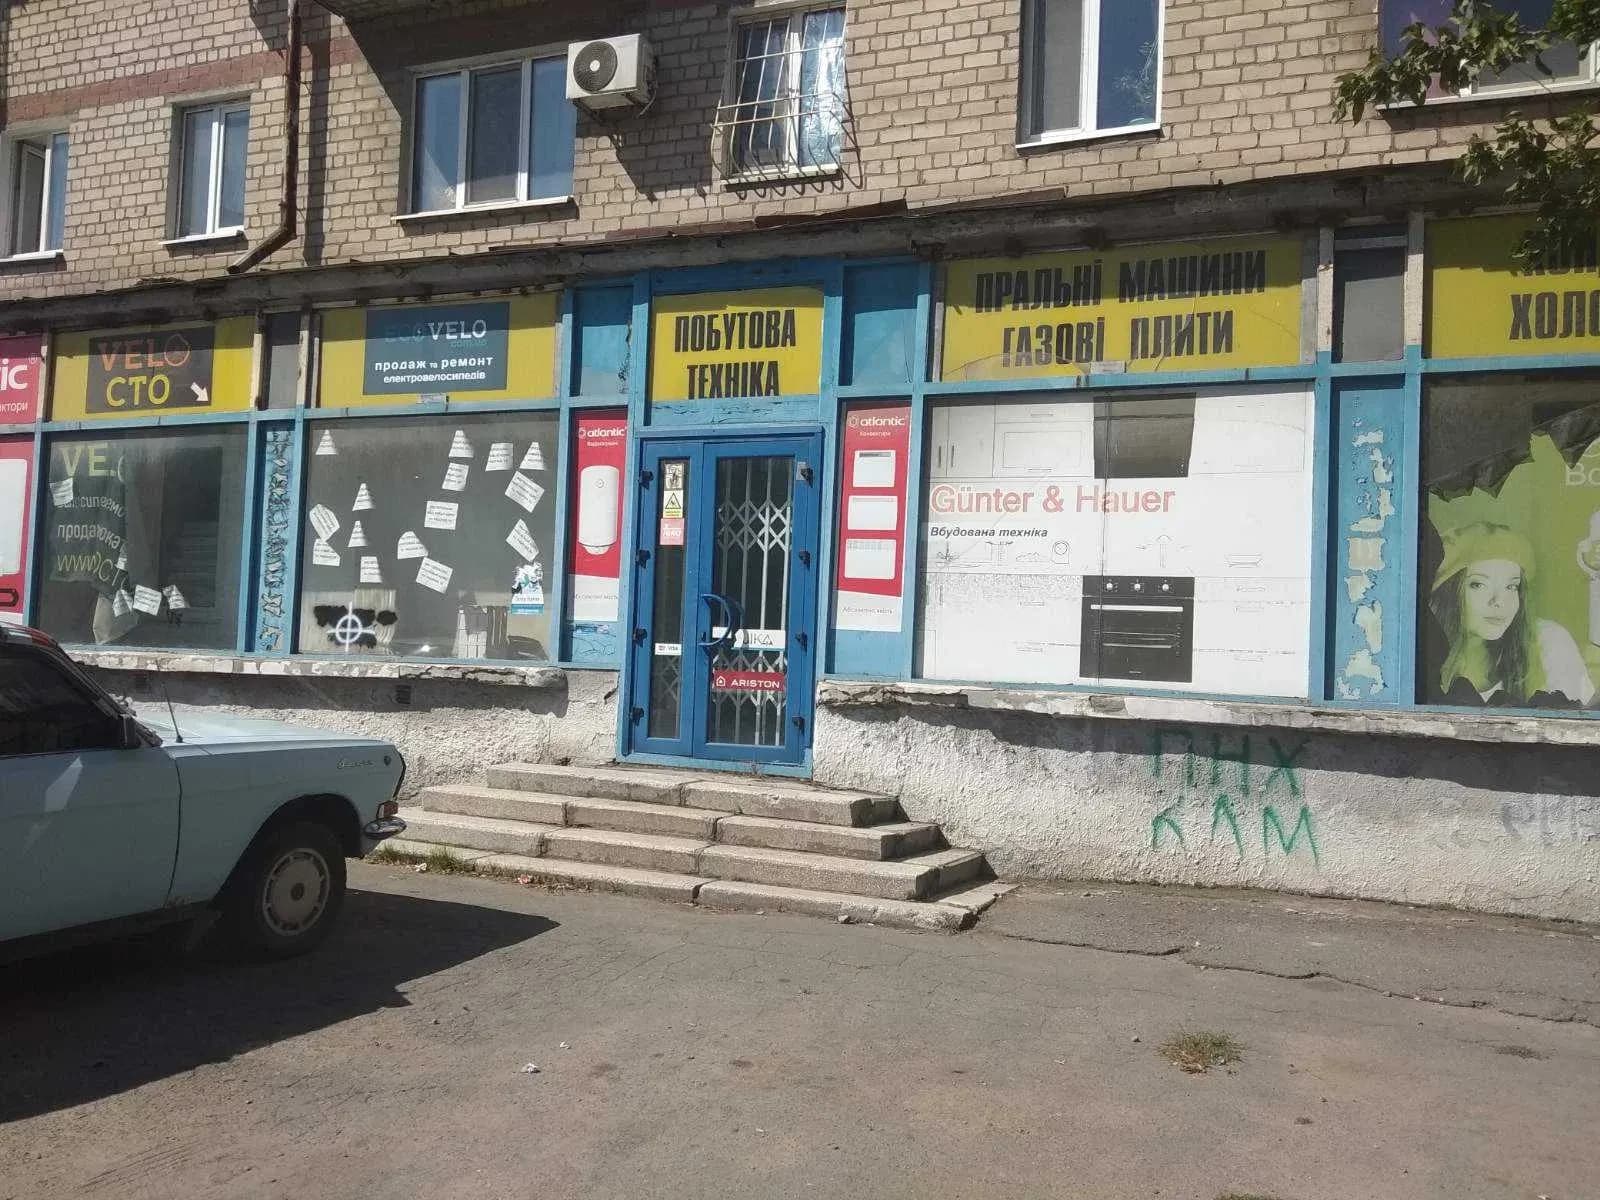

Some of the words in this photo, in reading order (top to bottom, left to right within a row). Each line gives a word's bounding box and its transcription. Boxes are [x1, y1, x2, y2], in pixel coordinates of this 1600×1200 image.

[1119, 250, 1266, 303] МАШИНИ
[674, 309, 797, 352] ПОБУТОВА
[1130, 310, 1234, 360] ПЛИТИ
[375, 361, 427, 372] продаж
[441, 358, 494, 370] ремонт
[0, 358, 28, 391] ic
[384, 371, 487, 384] електровелосипедів
[687, 360, 780, 400] ТЕХНІКА
[0, 402, 28, 413] ктори
[860, 416, 905, 427] atlantic
[587, 427, 625, 438] atlantic
[929, 484, 1034, 514] Günter
[1042, 484, 1065, 514] &
[1076, 484, 1177, 514] Hauer
[930, 526, 996, 539] Вбудована
[999, 527, 1049, 538] техніка
[731, 678, 780, 689] ARISTON
